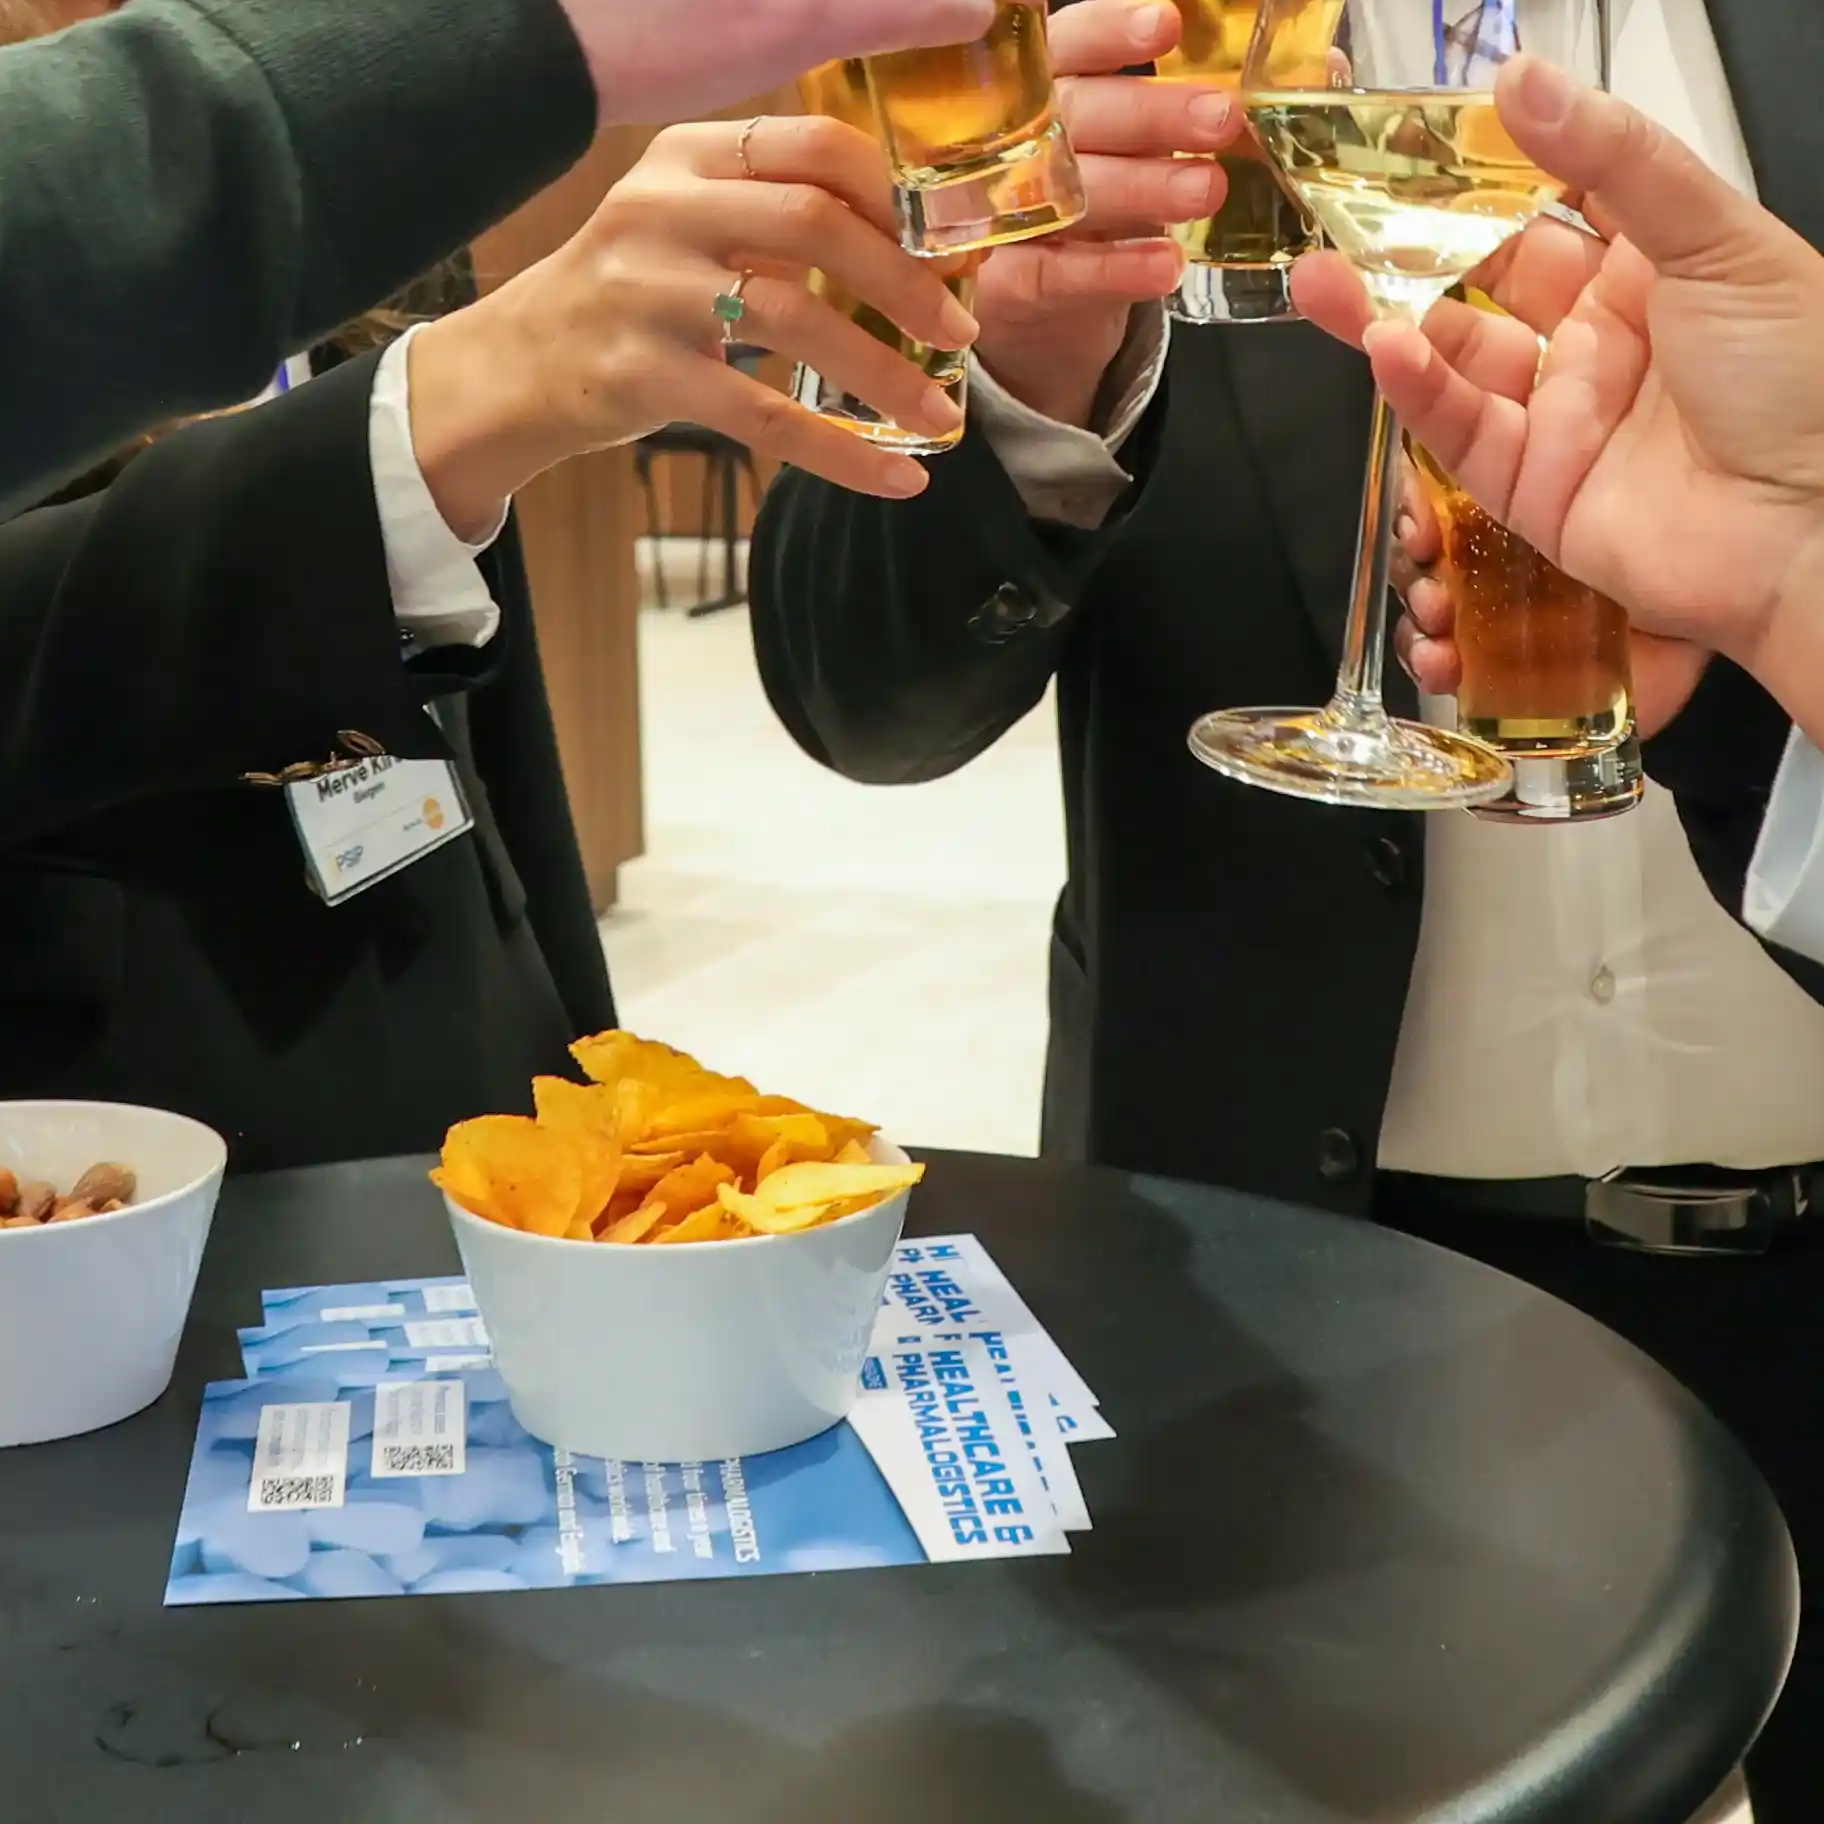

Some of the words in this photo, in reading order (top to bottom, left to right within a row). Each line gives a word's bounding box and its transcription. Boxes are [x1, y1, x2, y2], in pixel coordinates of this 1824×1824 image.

[316, 765, 368, 803] Merve
[892, 1352, 989, 1545] PHARMALOGISTICS
[927, 1350, 1024, 1516] HEALTHCARE
